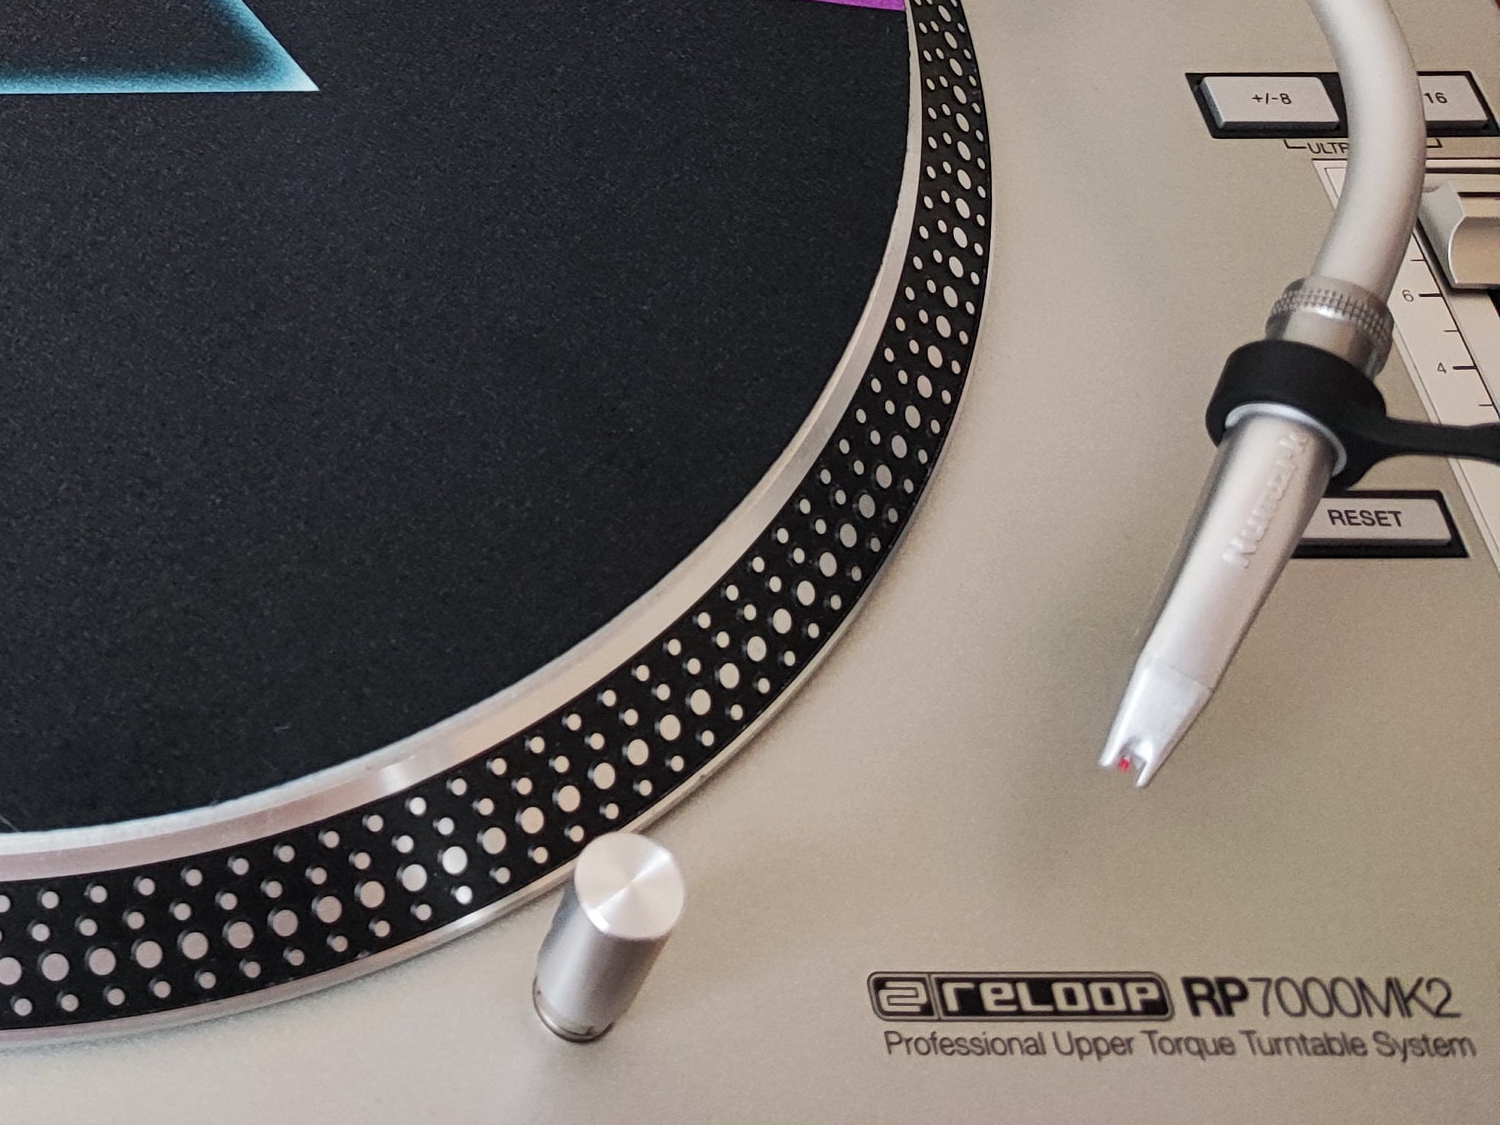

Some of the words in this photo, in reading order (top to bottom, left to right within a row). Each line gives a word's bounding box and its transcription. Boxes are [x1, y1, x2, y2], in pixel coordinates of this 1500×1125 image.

[1251, 93, 1293, 105] +/-8
[1307, 141, 1349, 154] ULTR
[1402, 288, 1415, 303] 6
[1436, 362, 1447, 375] 4
[1327, 508, 1402, 527] RESET
[1181, 976, 1462, 1019] RP7000MK2
[883, 1030, 1047, 1057] Professional
[1051, 1030, 1134, 1062] Upper
[1139, 1029, 1236, 1062] Torque
[1238, 1029, 1368, 1057] Turntable
[1372, 1030, 1478, 1063] System
